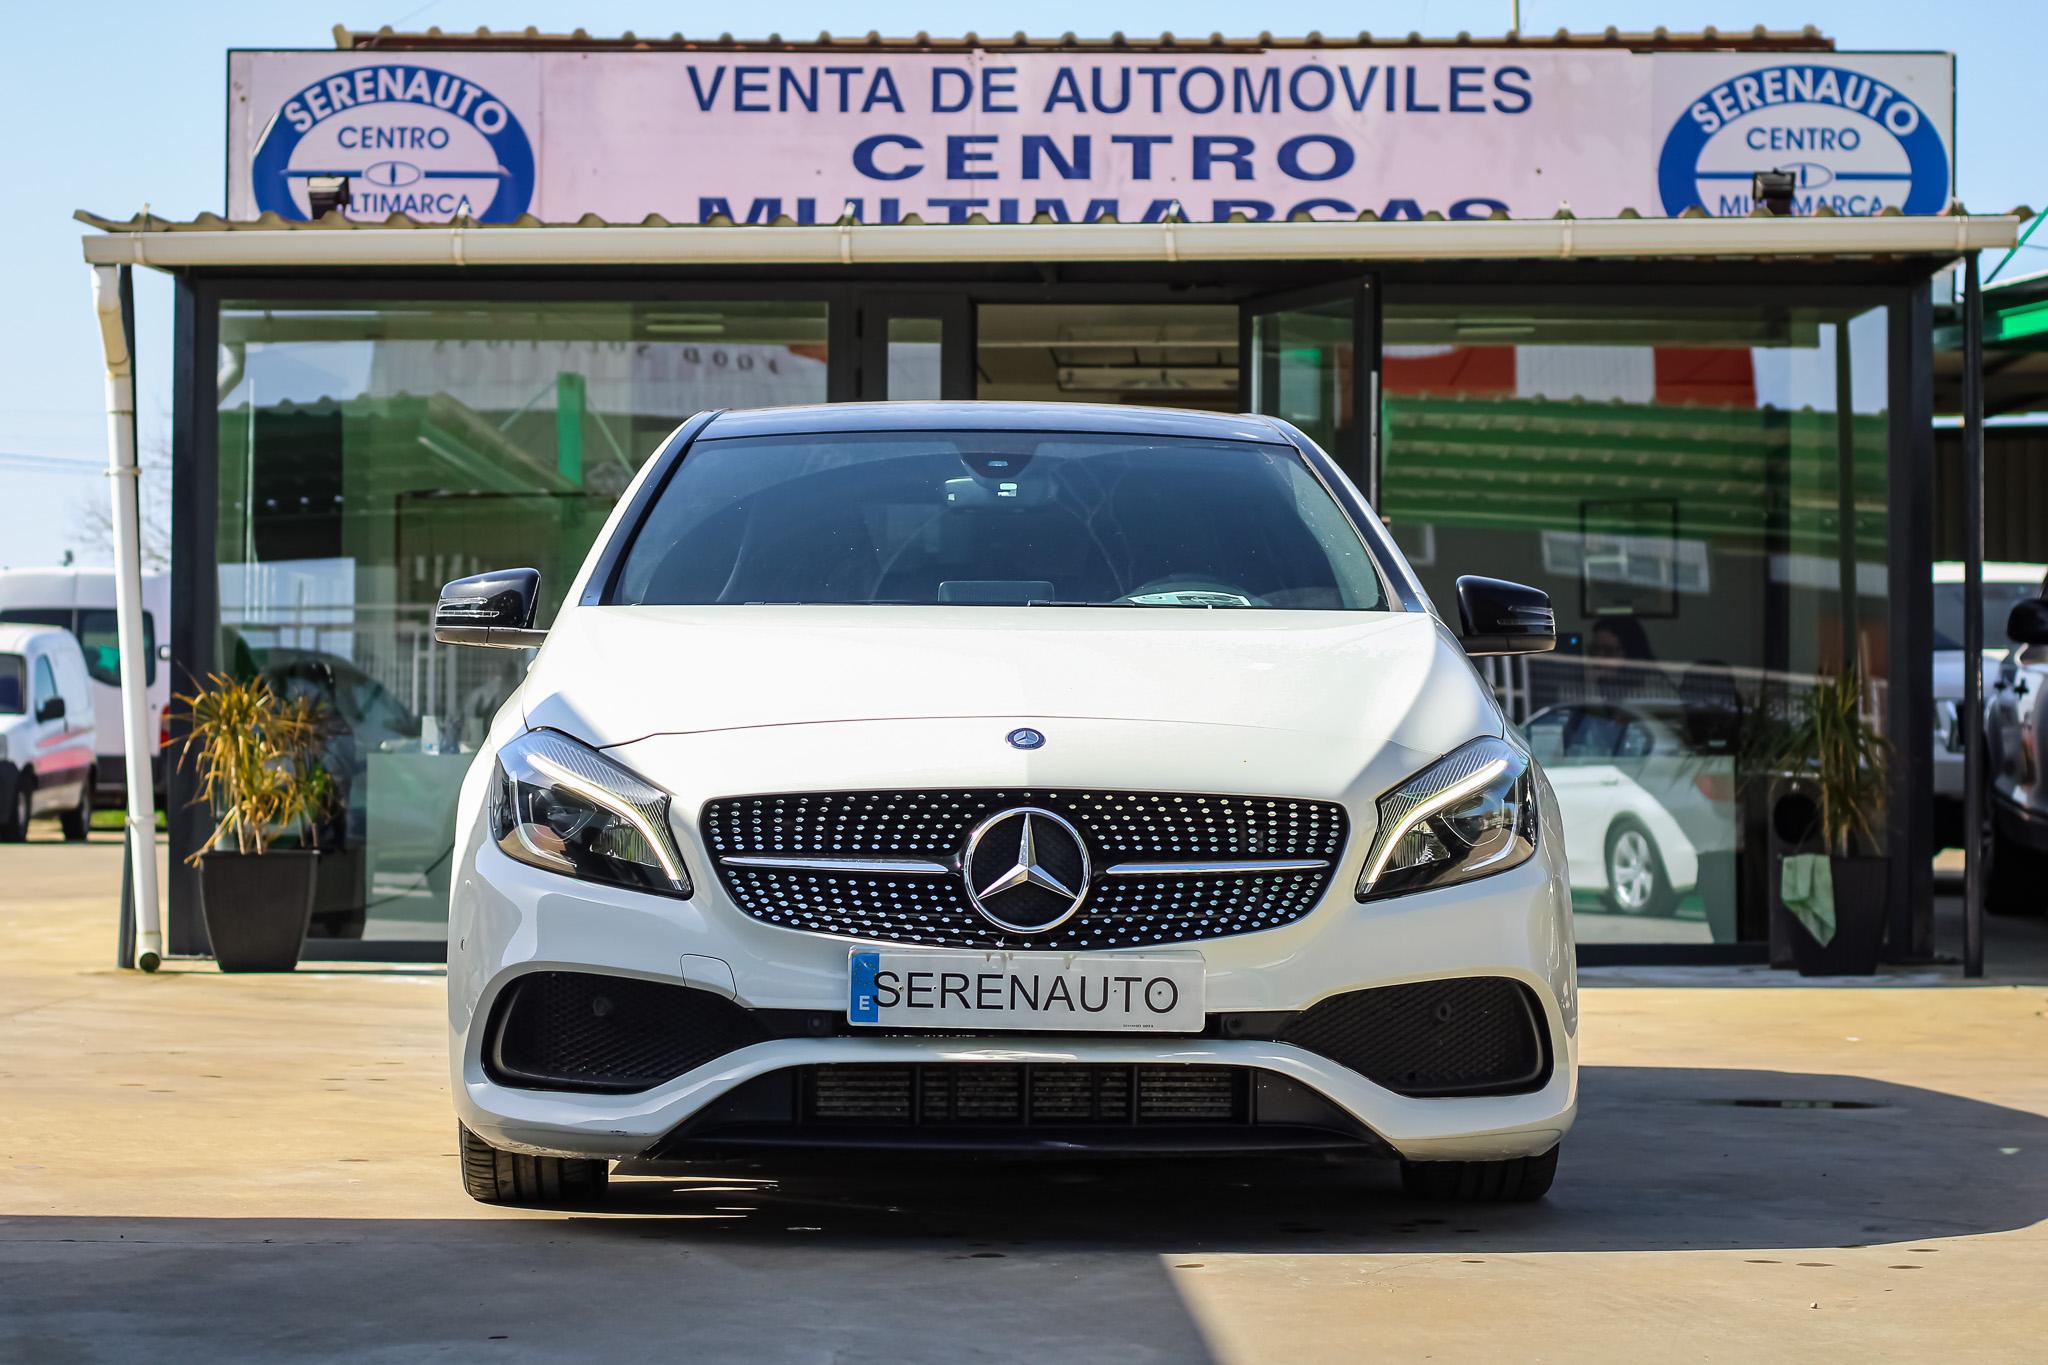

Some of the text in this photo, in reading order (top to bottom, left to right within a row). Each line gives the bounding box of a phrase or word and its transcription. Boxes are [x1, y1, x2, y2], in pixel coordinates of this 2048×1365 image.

[285, 68, 507, 135] SERENAUTO
[687, 65, 1533, 115] VENTA DE AUTOMOVILES
[1691, 68, 1919, 136] SERENAUTO
[338, 127, 449, 148] CENTRO
[852, 134, 1356, 181] CENTRO
[1746, 127, 1860, 150] CENTRO
[859, 996, 870, 1011] E
[872, 971, 1179, 1014] SERENAUTO
